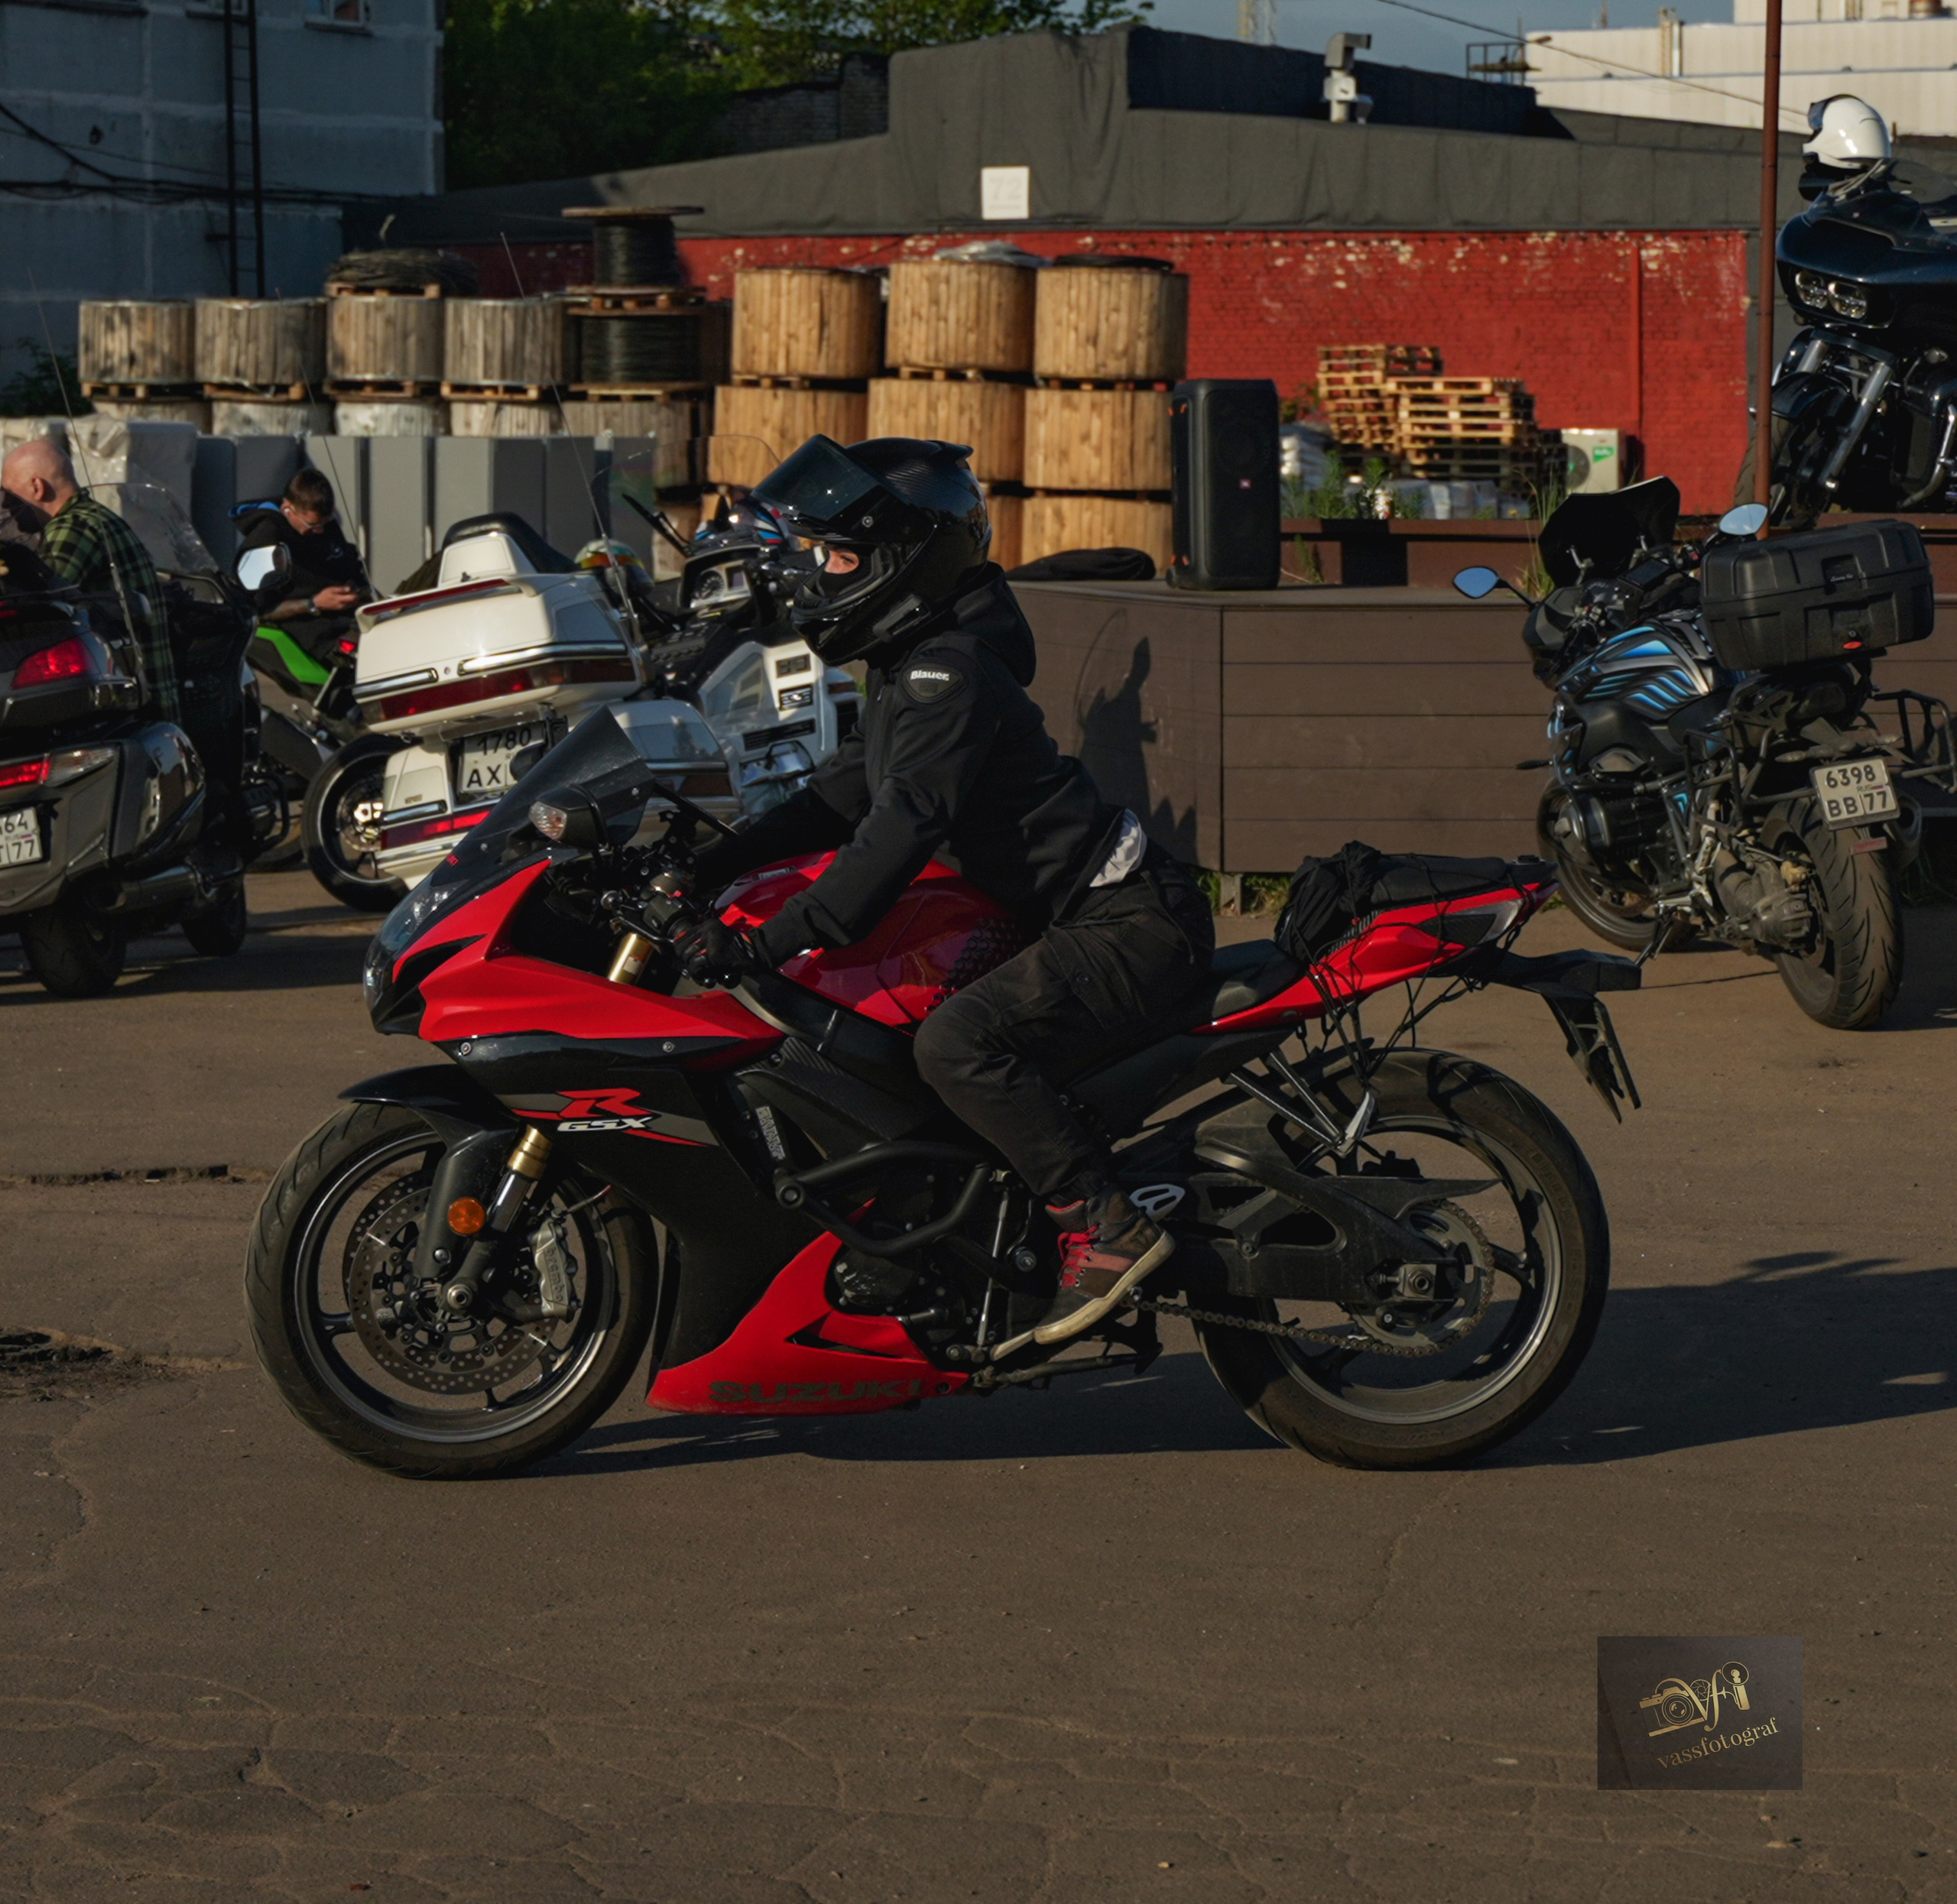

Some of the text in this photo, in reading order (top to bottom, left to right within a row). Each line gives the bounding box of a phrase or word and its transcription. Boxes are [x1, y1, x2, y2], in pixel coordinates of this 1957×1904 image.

[478, 728, 531, 755] 1780
[1826, 765, 1875, 788] 6398
[1864, 791, 1886, 810] 77
[12, 839, 34, 860] 77
[556, 1088, 651, 1117] R
[557, 1117, 653, 1131] GSX
[546, 1247, 564, 1302] brembo
[709, 1380, 921, 1403] SUZUKI
